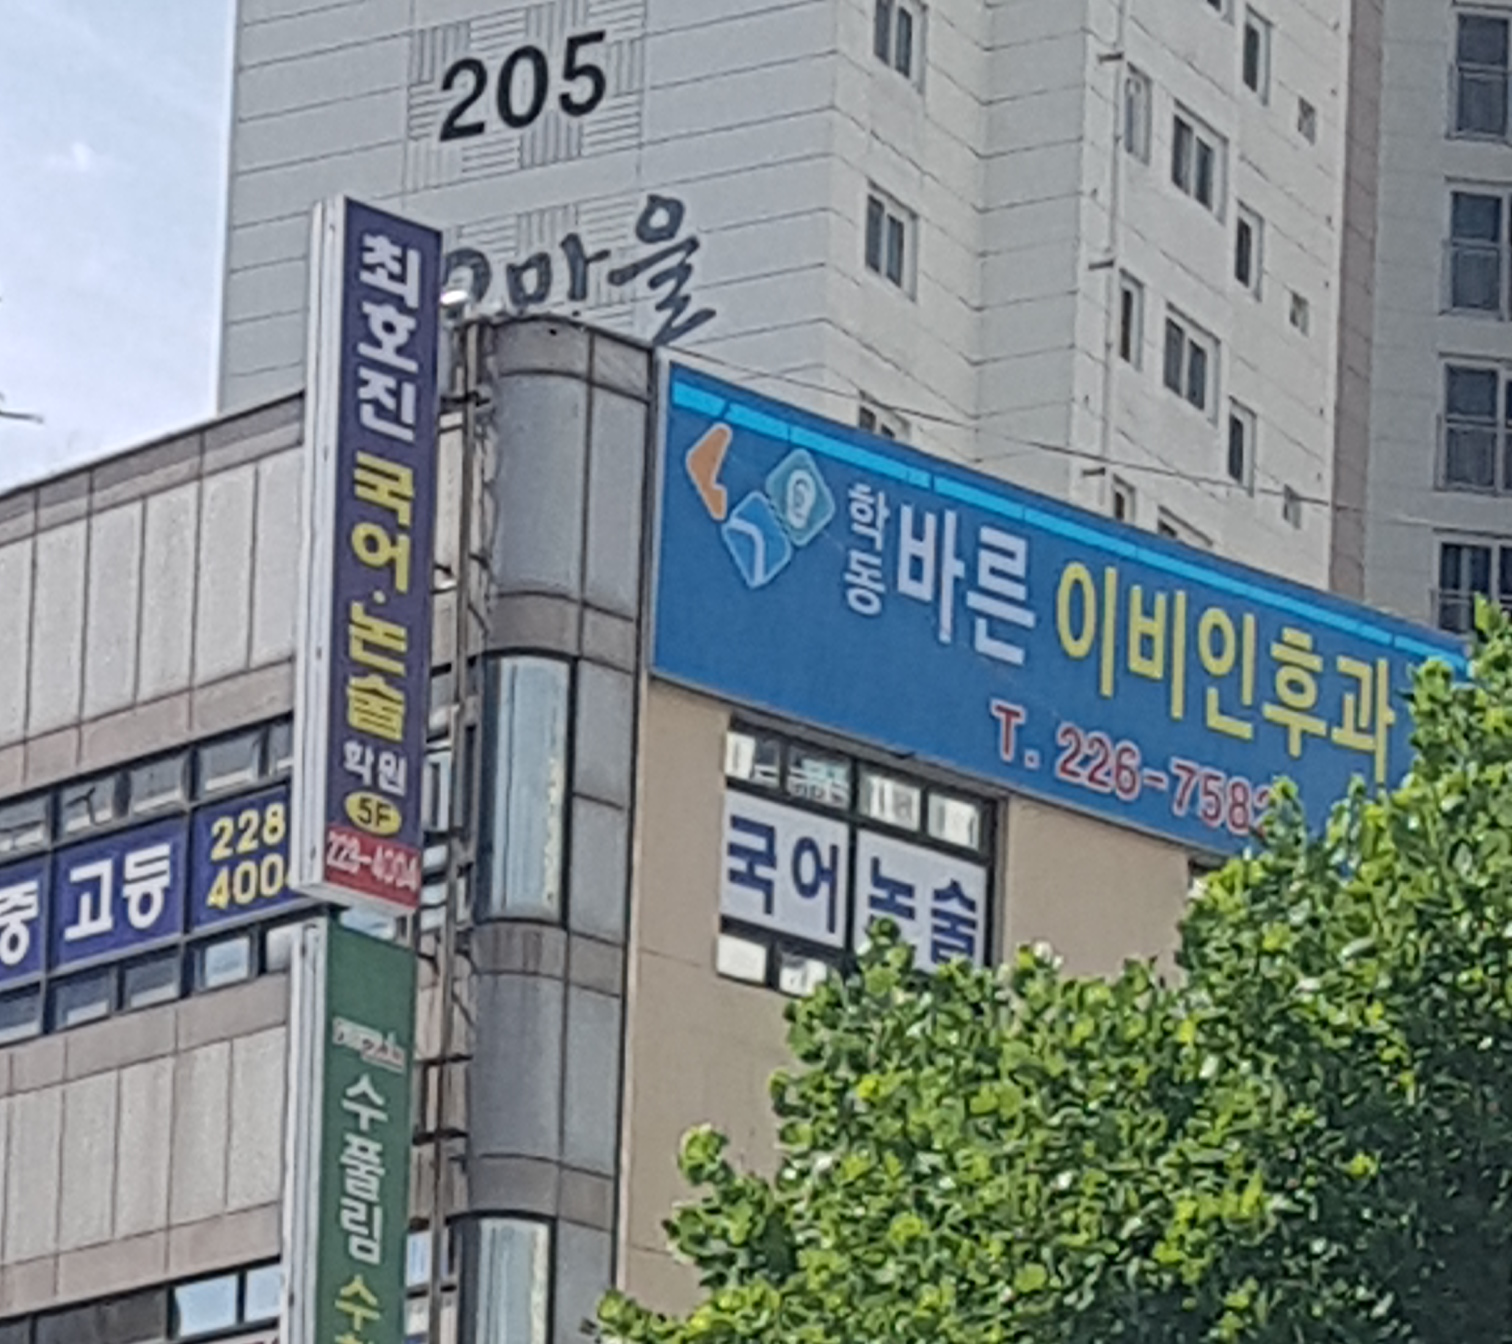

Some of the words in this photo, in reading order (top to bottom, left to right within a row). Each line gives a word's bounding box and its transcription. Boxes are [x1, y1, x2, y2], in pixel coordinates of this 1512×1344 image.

[439, 30, 609, 143] 205
[358, 230, 421, 444] 최호진
[896, 500, 1038, 668] 바른
[1056, 560, 1396, 788] 이비인후과
[344, 740, 408, 797] 학원
[356, 796, 392, 828] 5F
[205, 852, 290, 910] 400
[210, 802, 286, 861] 228
[726, 814, 840, 935] 국어
[340, 1073, 388, 1266] 수풀림
